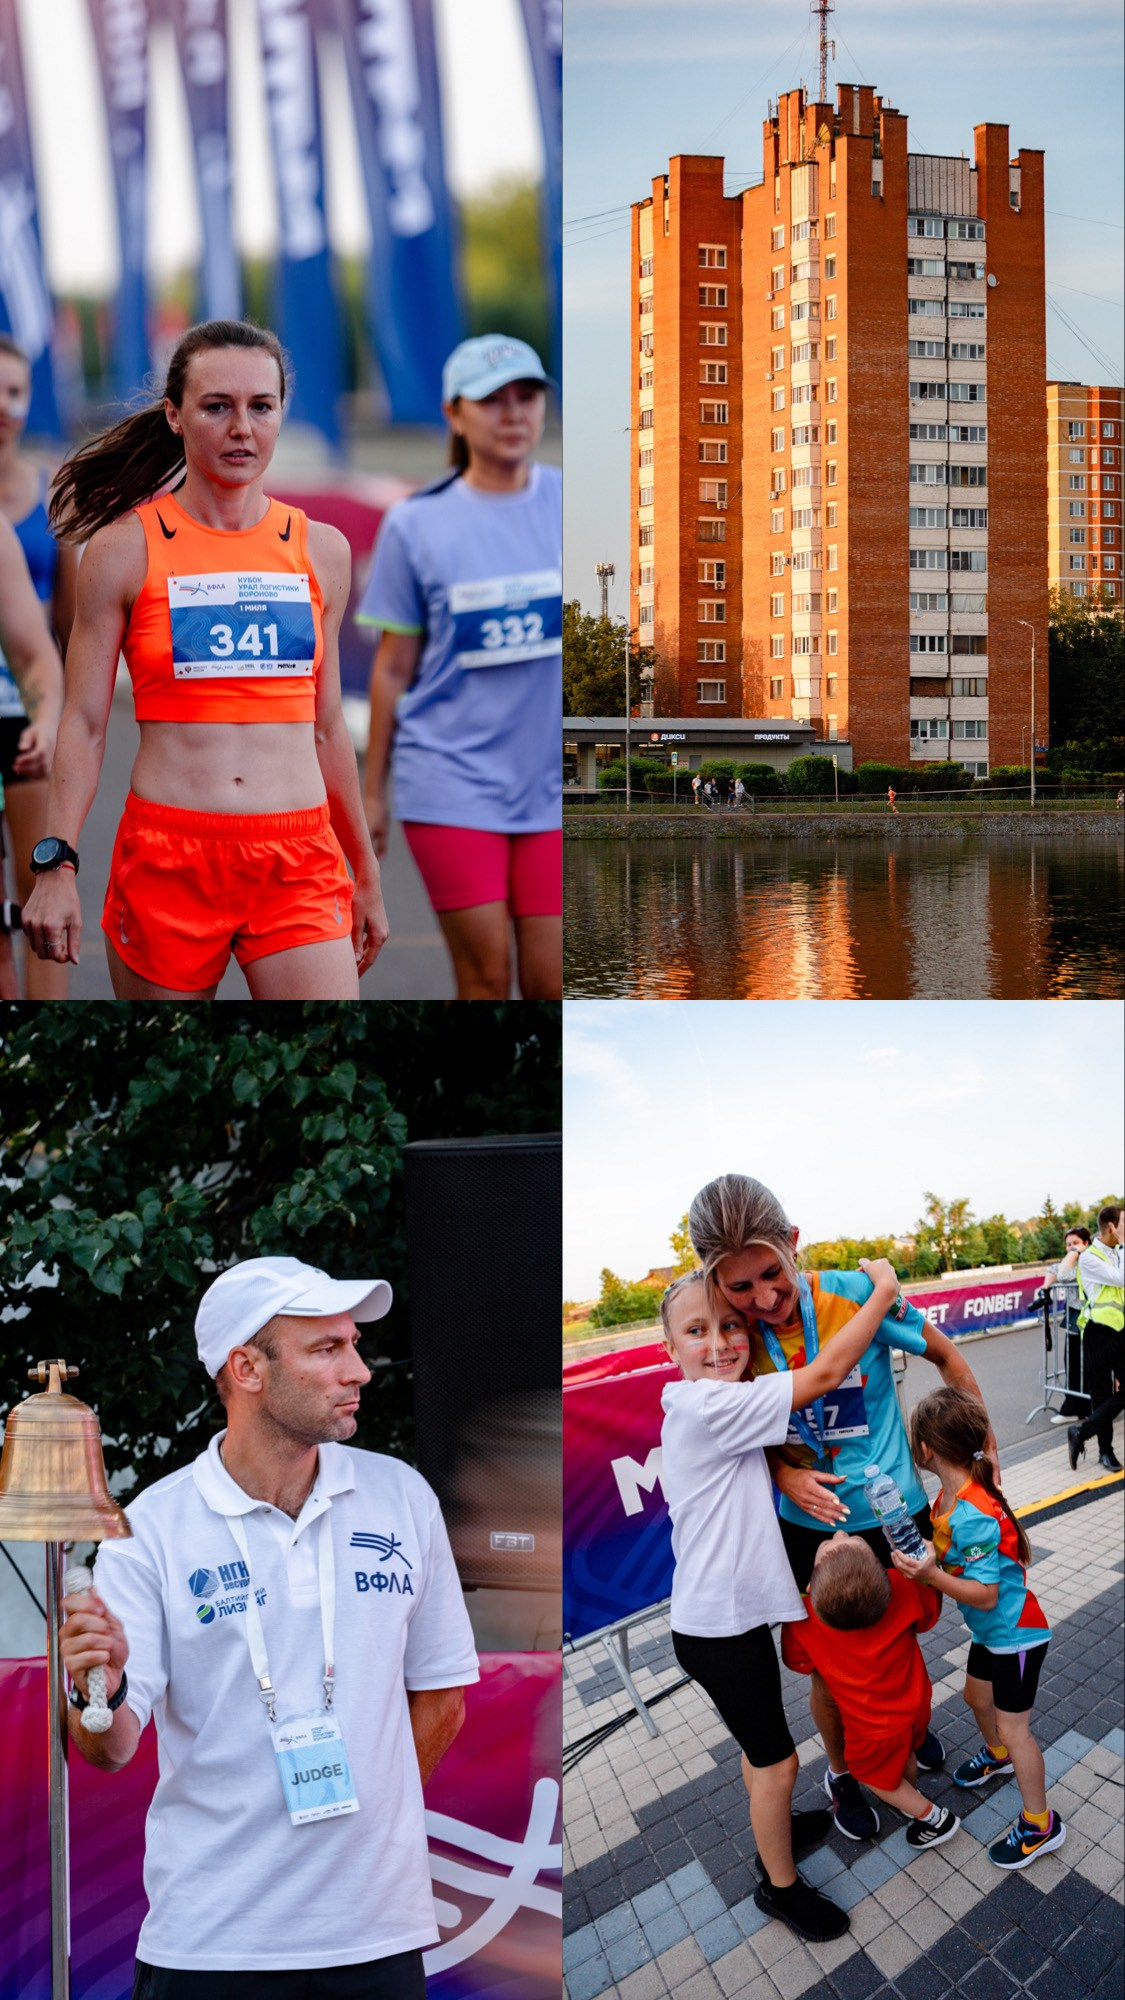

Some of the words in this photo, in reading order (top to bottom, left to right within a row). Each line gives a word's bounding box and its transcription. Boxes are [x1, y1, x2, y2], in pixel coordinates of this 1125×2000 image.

[238, 583, 258, 591] УРАЛ
[259, 584, 300, 592] ЛОГИСТИКИ
[244, 604, 268, 612] МИЛЯ
[209, 623, 279, 657] 341
[480, 611, 545, 650] 332
[754, 733, 790, 741] ПРОДУКТЫ
[963, 1291, 1023, 1319] FONBET
[355, 1571, 414, 1596] ВФЛА
[290, 1763, 344, 1786] JUDGE
